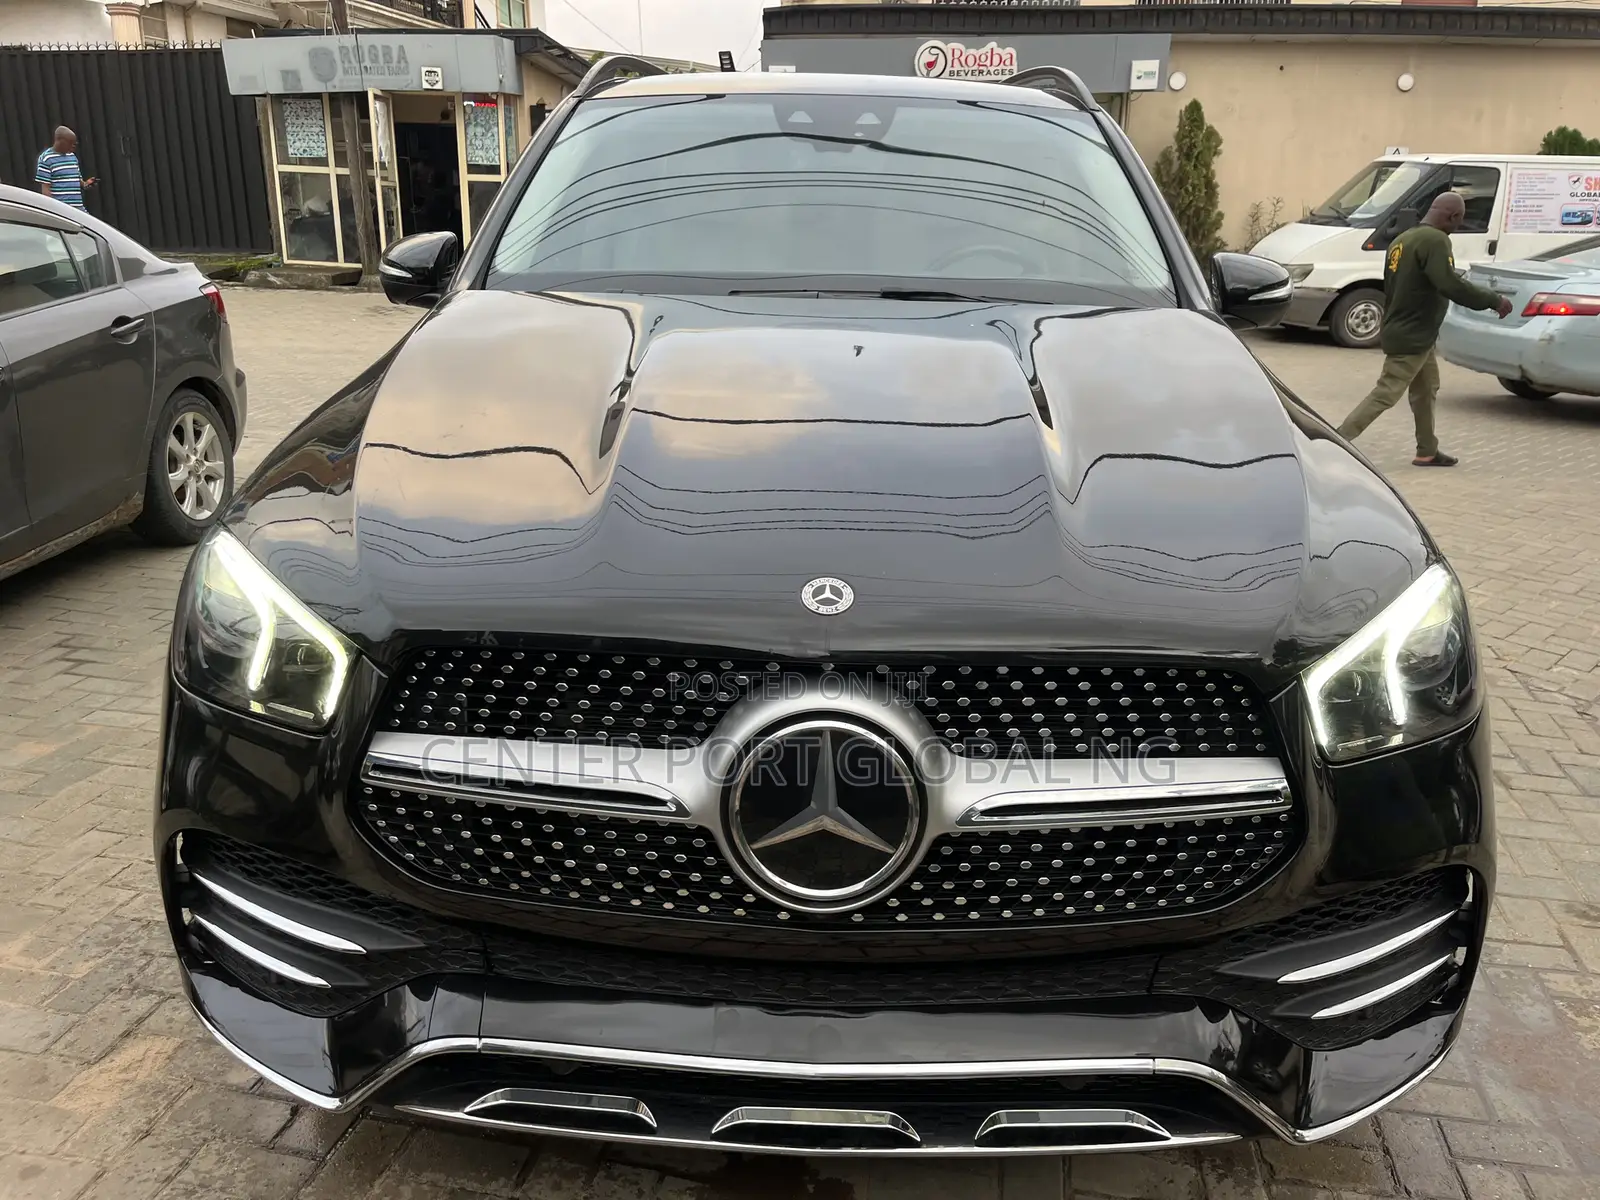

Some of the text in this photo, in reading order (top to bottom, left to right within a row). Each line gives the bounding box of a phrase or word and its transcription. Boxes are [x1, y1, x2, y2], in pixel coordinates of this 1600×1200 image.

[338, 44, 409, 65] ROGBA
[951, 47, 1014, 70] Rogba
[948, 68, 1014, 77] BEVERAGES
